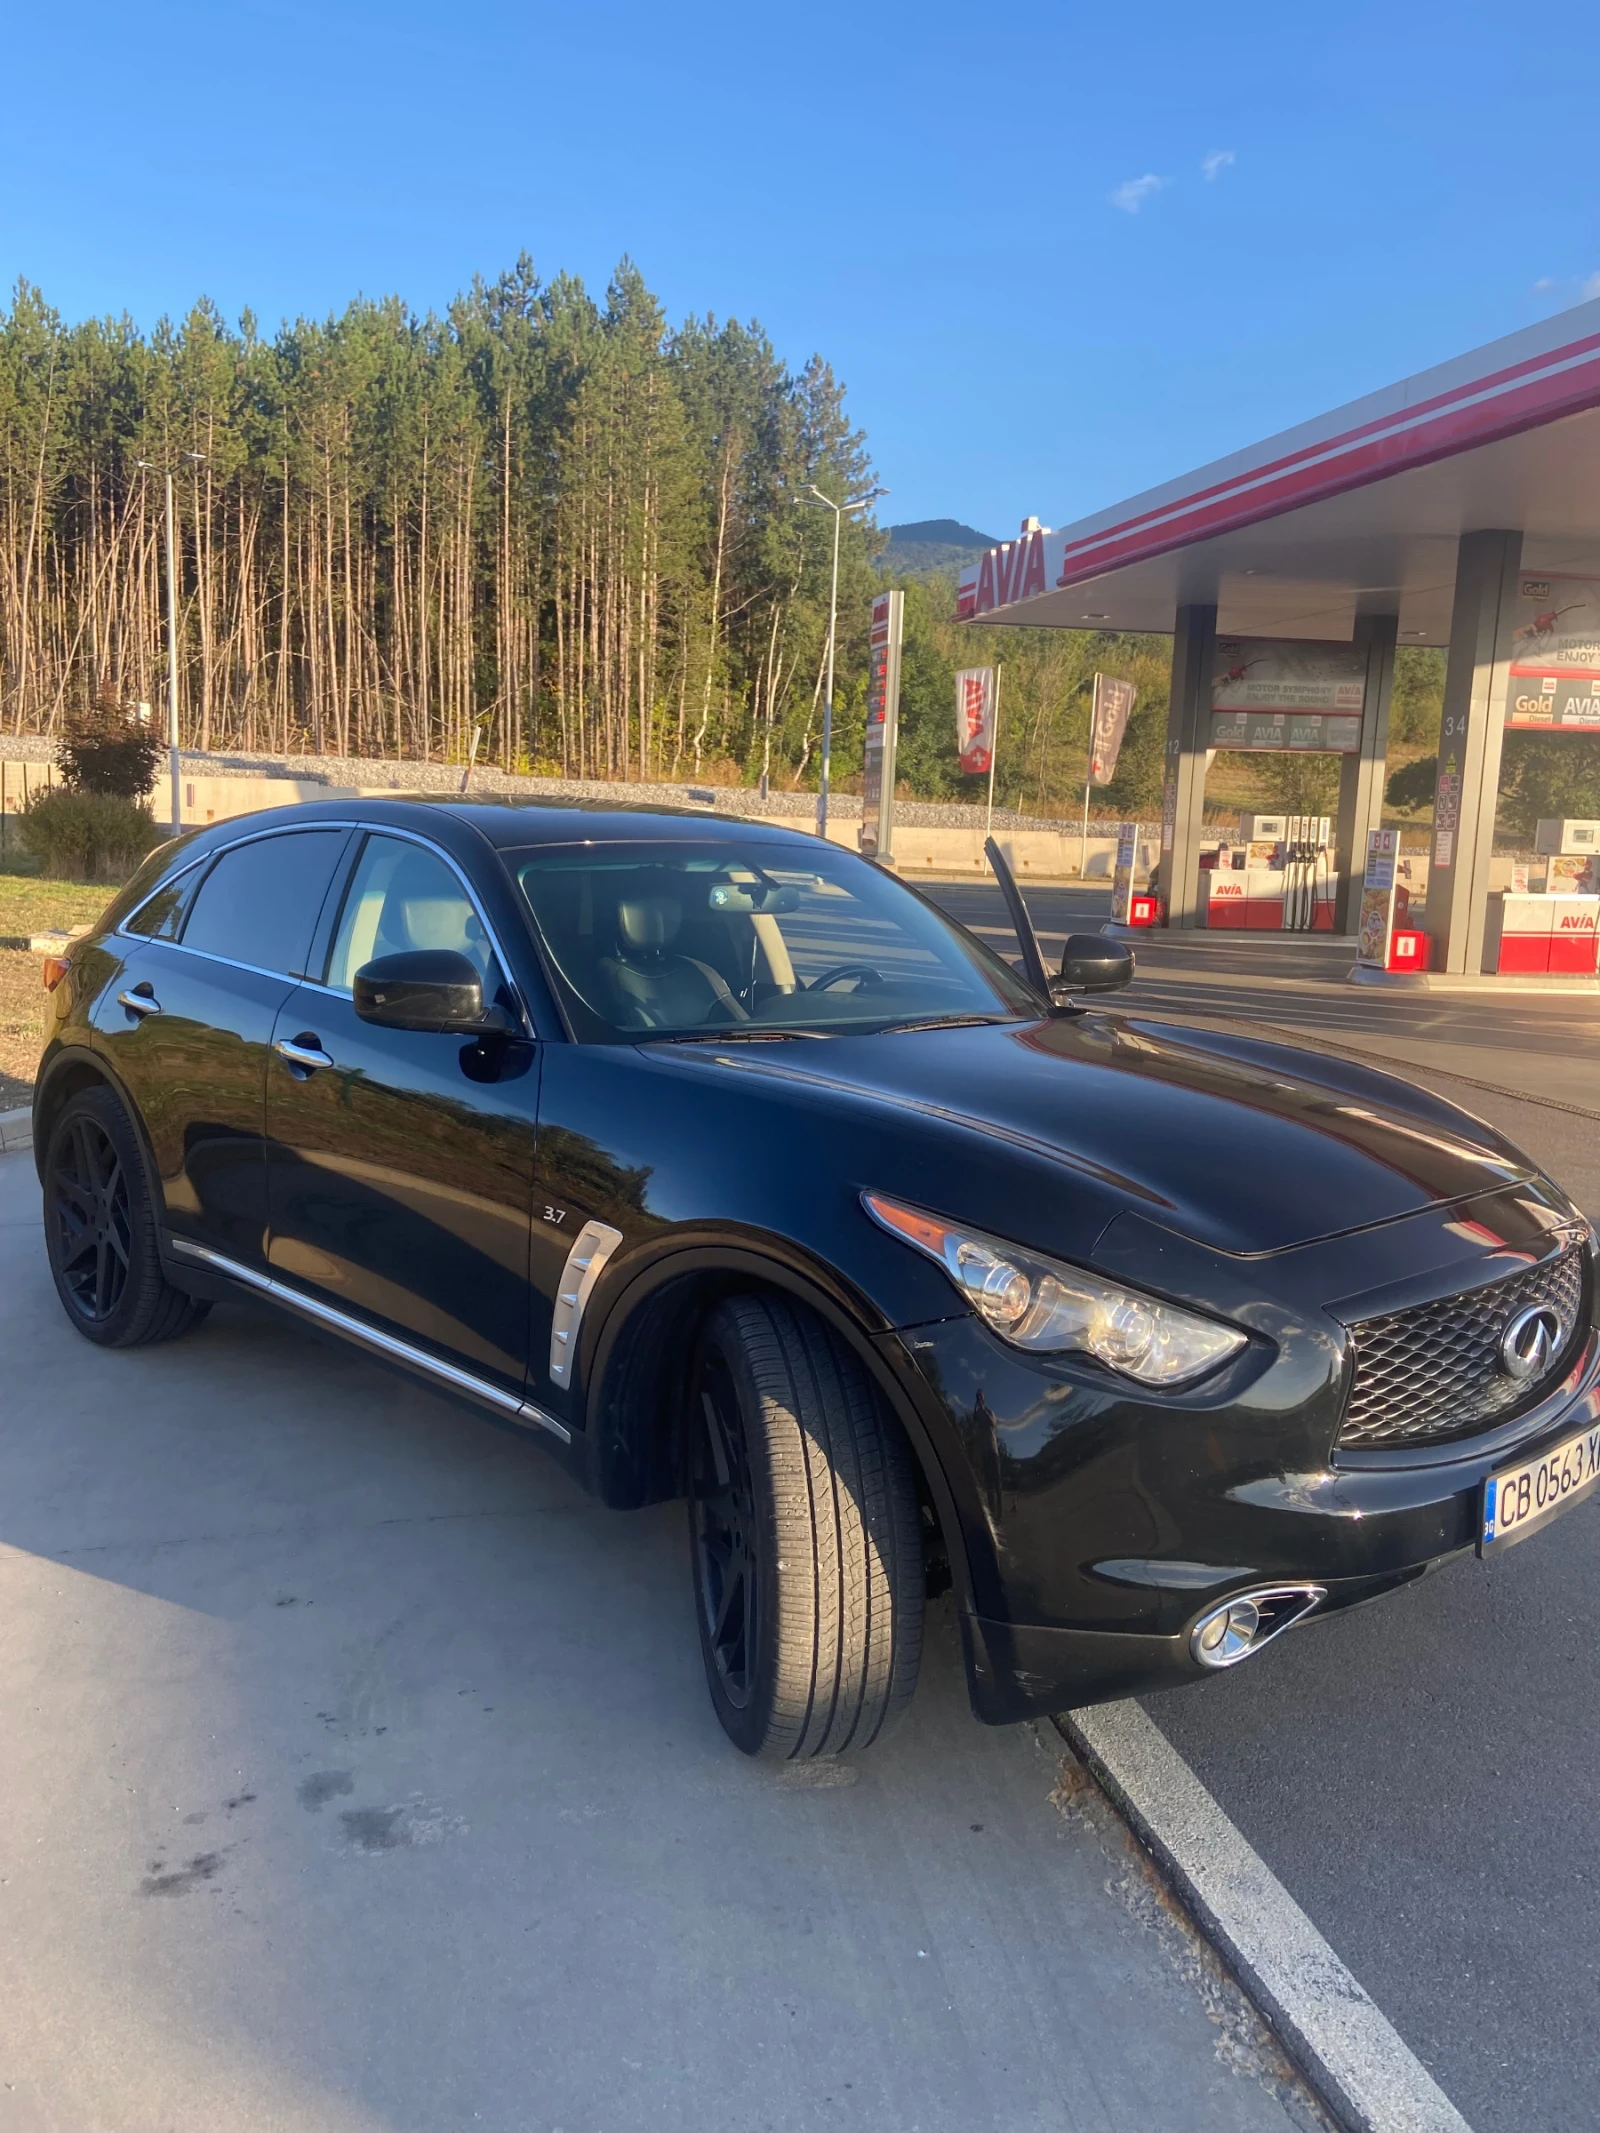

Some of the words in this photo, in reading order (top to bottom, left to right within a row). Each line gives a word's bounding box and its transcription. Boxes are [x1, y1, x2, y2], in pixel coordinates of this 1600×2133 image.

[1524, 583, 1548, 596] Gold
[1556, 650, 1596, 663] ENJOY
[1247, 684, 1280, 693] MOTOR
[1282, 685, 1332, 695] SYMPHONY
[1246, 693, 1277, 701] ENJOY
[1279, 694, 1296, 703] THE
[1299, 695, 1330, 704] SOUND
[1515, 695, 1554, 713] Gold
[1097, 688, 1126, 737] Gold
[1563, 697, 1600, 715] AVIA
[1528, 714, 1551, 723] Diesel
[1216, 725, 1245, 738] Gold
[1254, 727, 1282, 740] AVIA
[1290, 729, 1319, 741] AVIA
[543, 1205, 567, 1224] 3.7
[1500, 1472, 1531, 1527] CB
[1536, 1443, 1583, 1508] 0563
[1586, 1431, 1600, 1479] X
